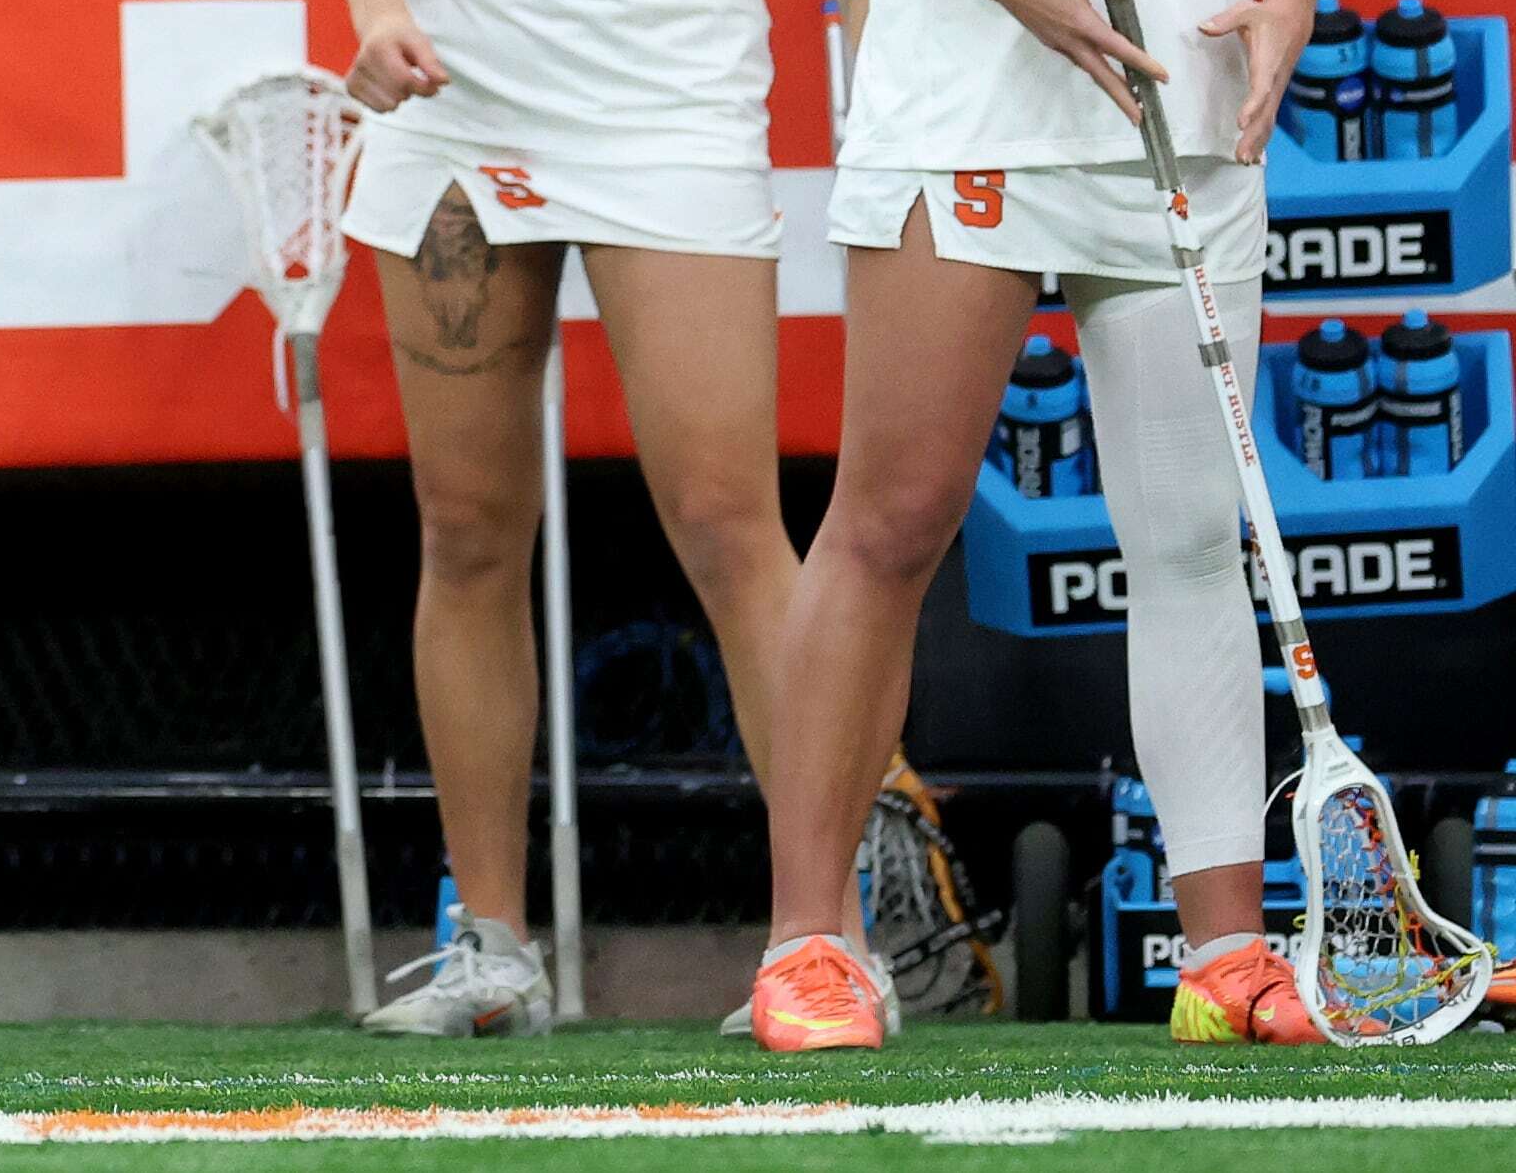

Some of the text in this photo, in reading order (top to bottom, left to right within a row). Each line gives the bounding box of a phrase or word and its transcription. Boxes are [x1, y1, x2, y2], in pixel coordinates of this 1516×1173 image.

[954, 169, 1006, 229] S
[1265, 223, 1426, 281] RADE
[1210, 325, 1236, 389] HRT
[1228, 393, 1257, 467] HUSTLE
[1049, 538, 1438, 614] POADE
[1292, 644, 1317, 680] S
